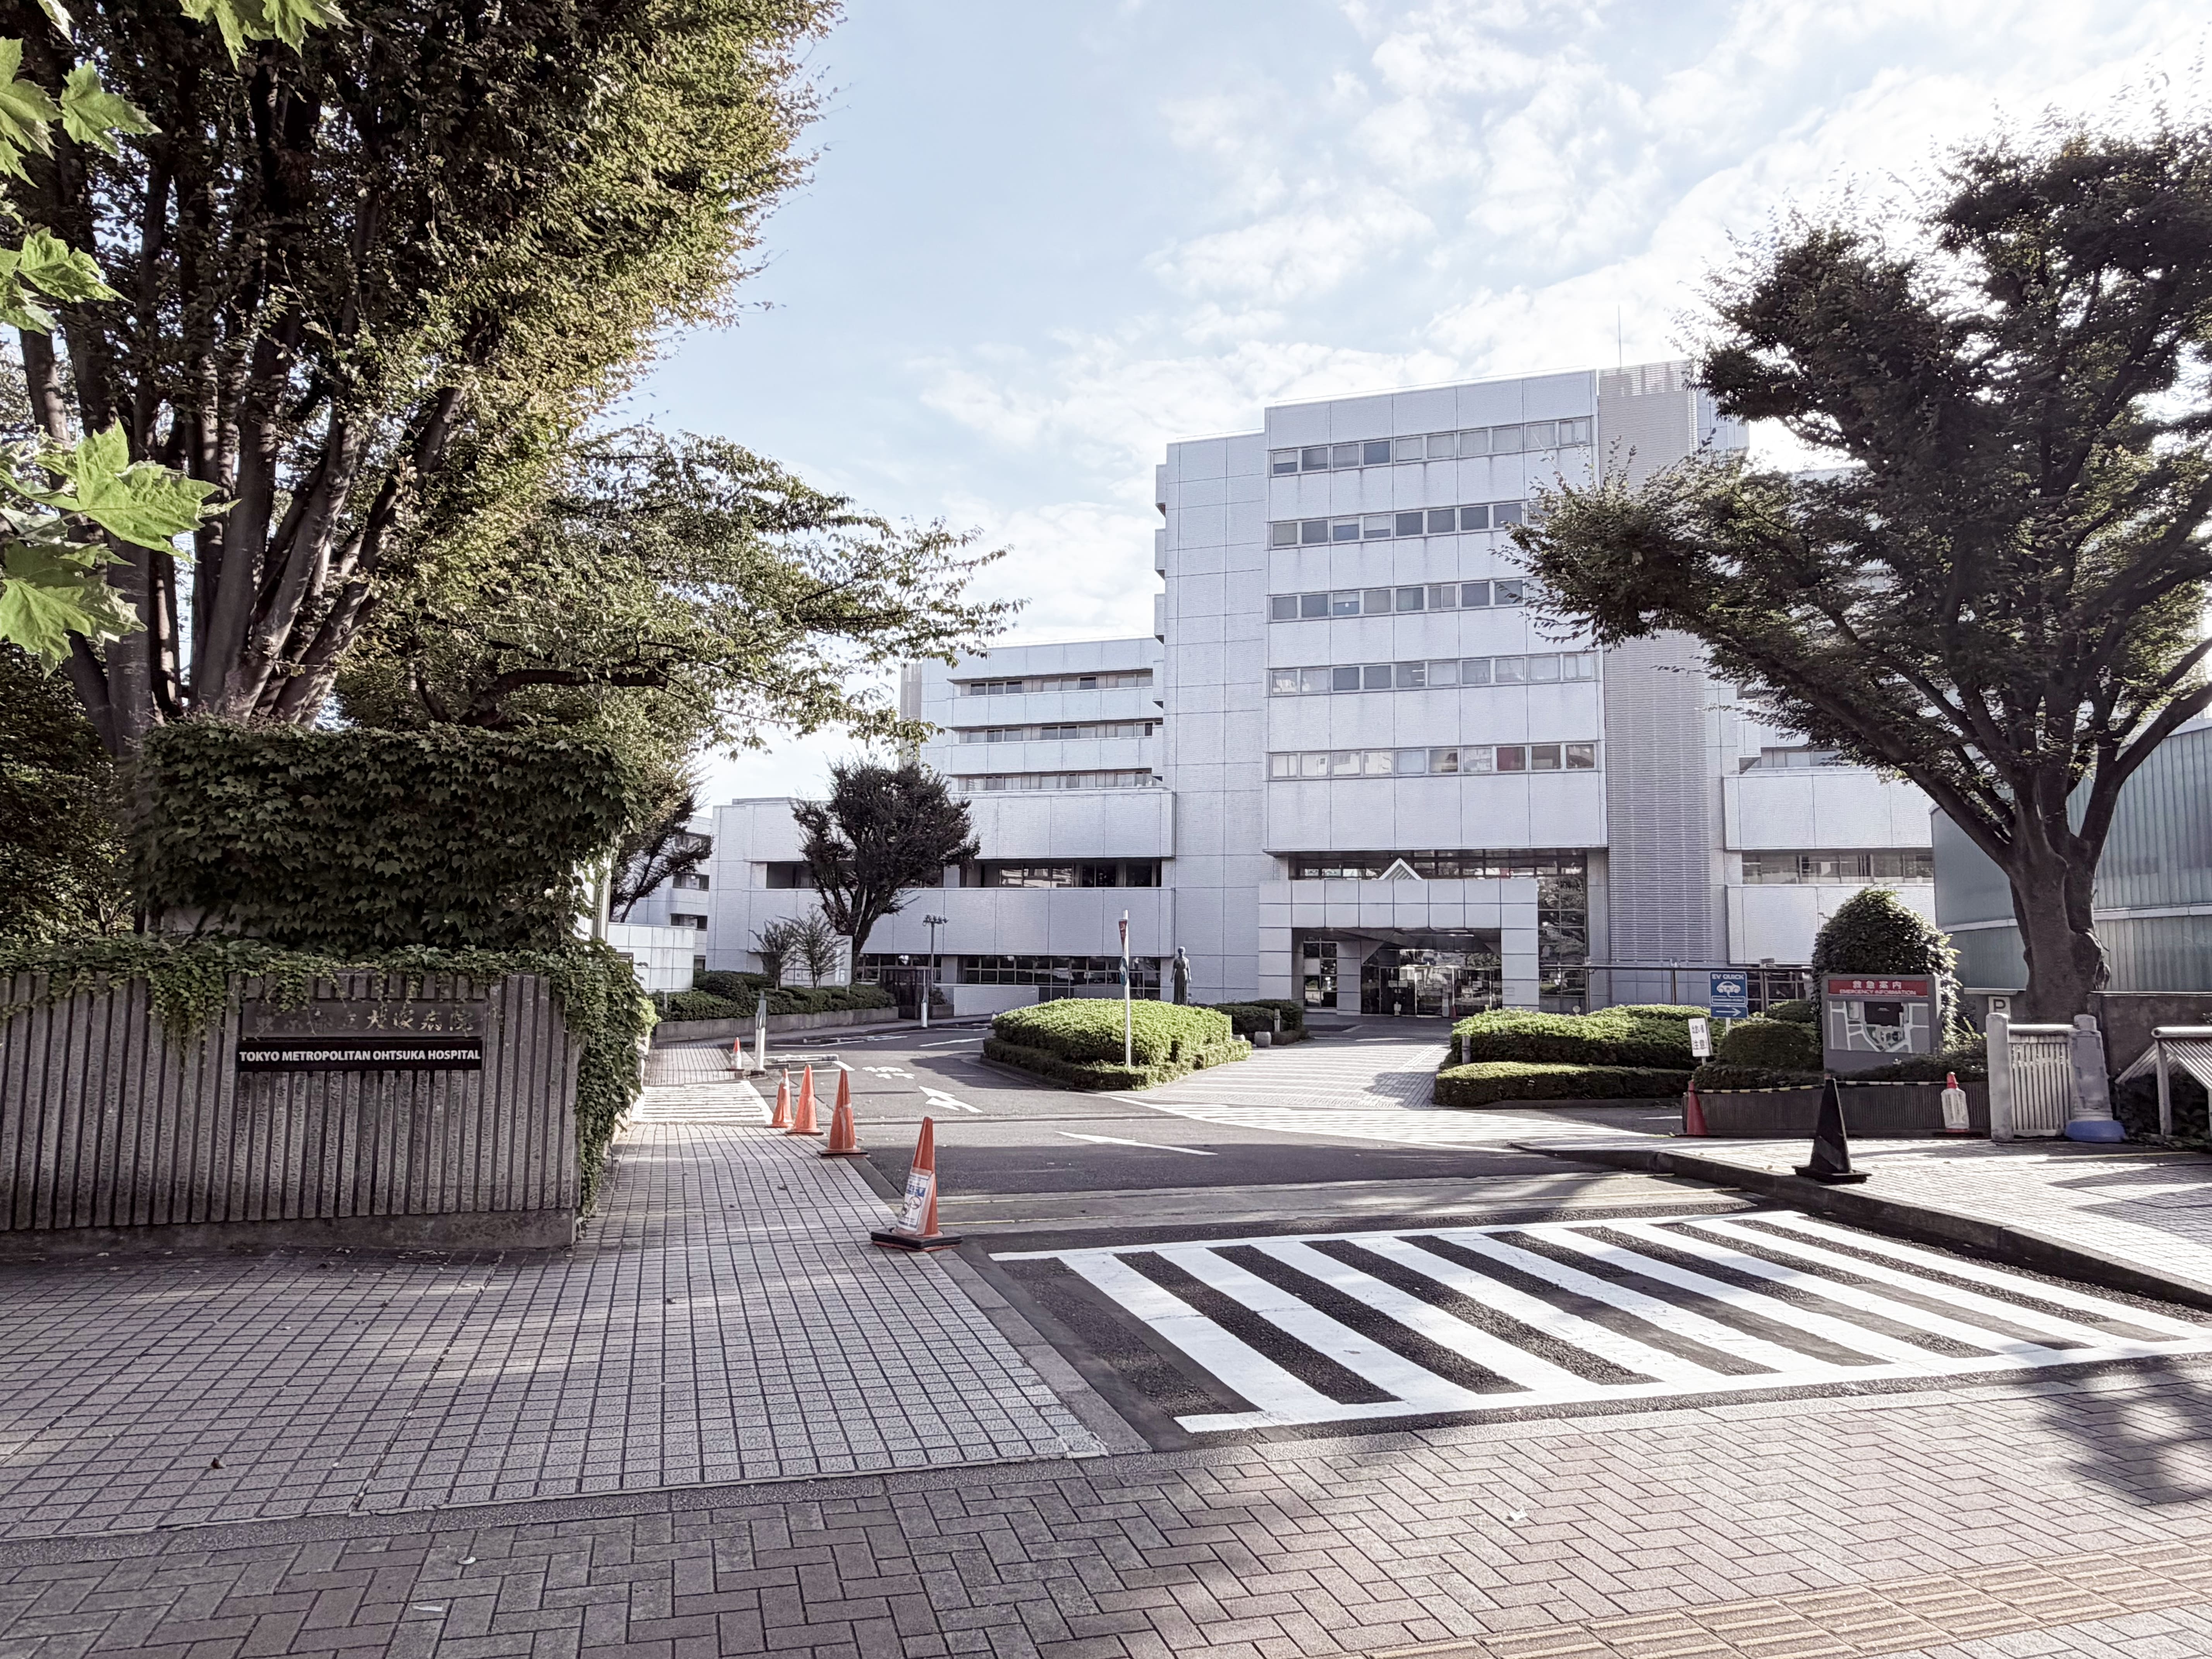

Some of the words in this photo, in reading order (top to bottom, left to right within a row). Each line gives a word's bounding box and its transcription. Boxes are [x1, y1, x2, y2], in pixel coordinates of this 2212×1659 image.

[1993, 999, 2006, 1012] P
[239, 1051, 280, 1061] TOKYO
[282, 1051, 371, 1061] METROPOLITAN
[373, 1050, 426, 1060] OHTSUKA
[428, 1050, 481, 1060] HOSPITAL
